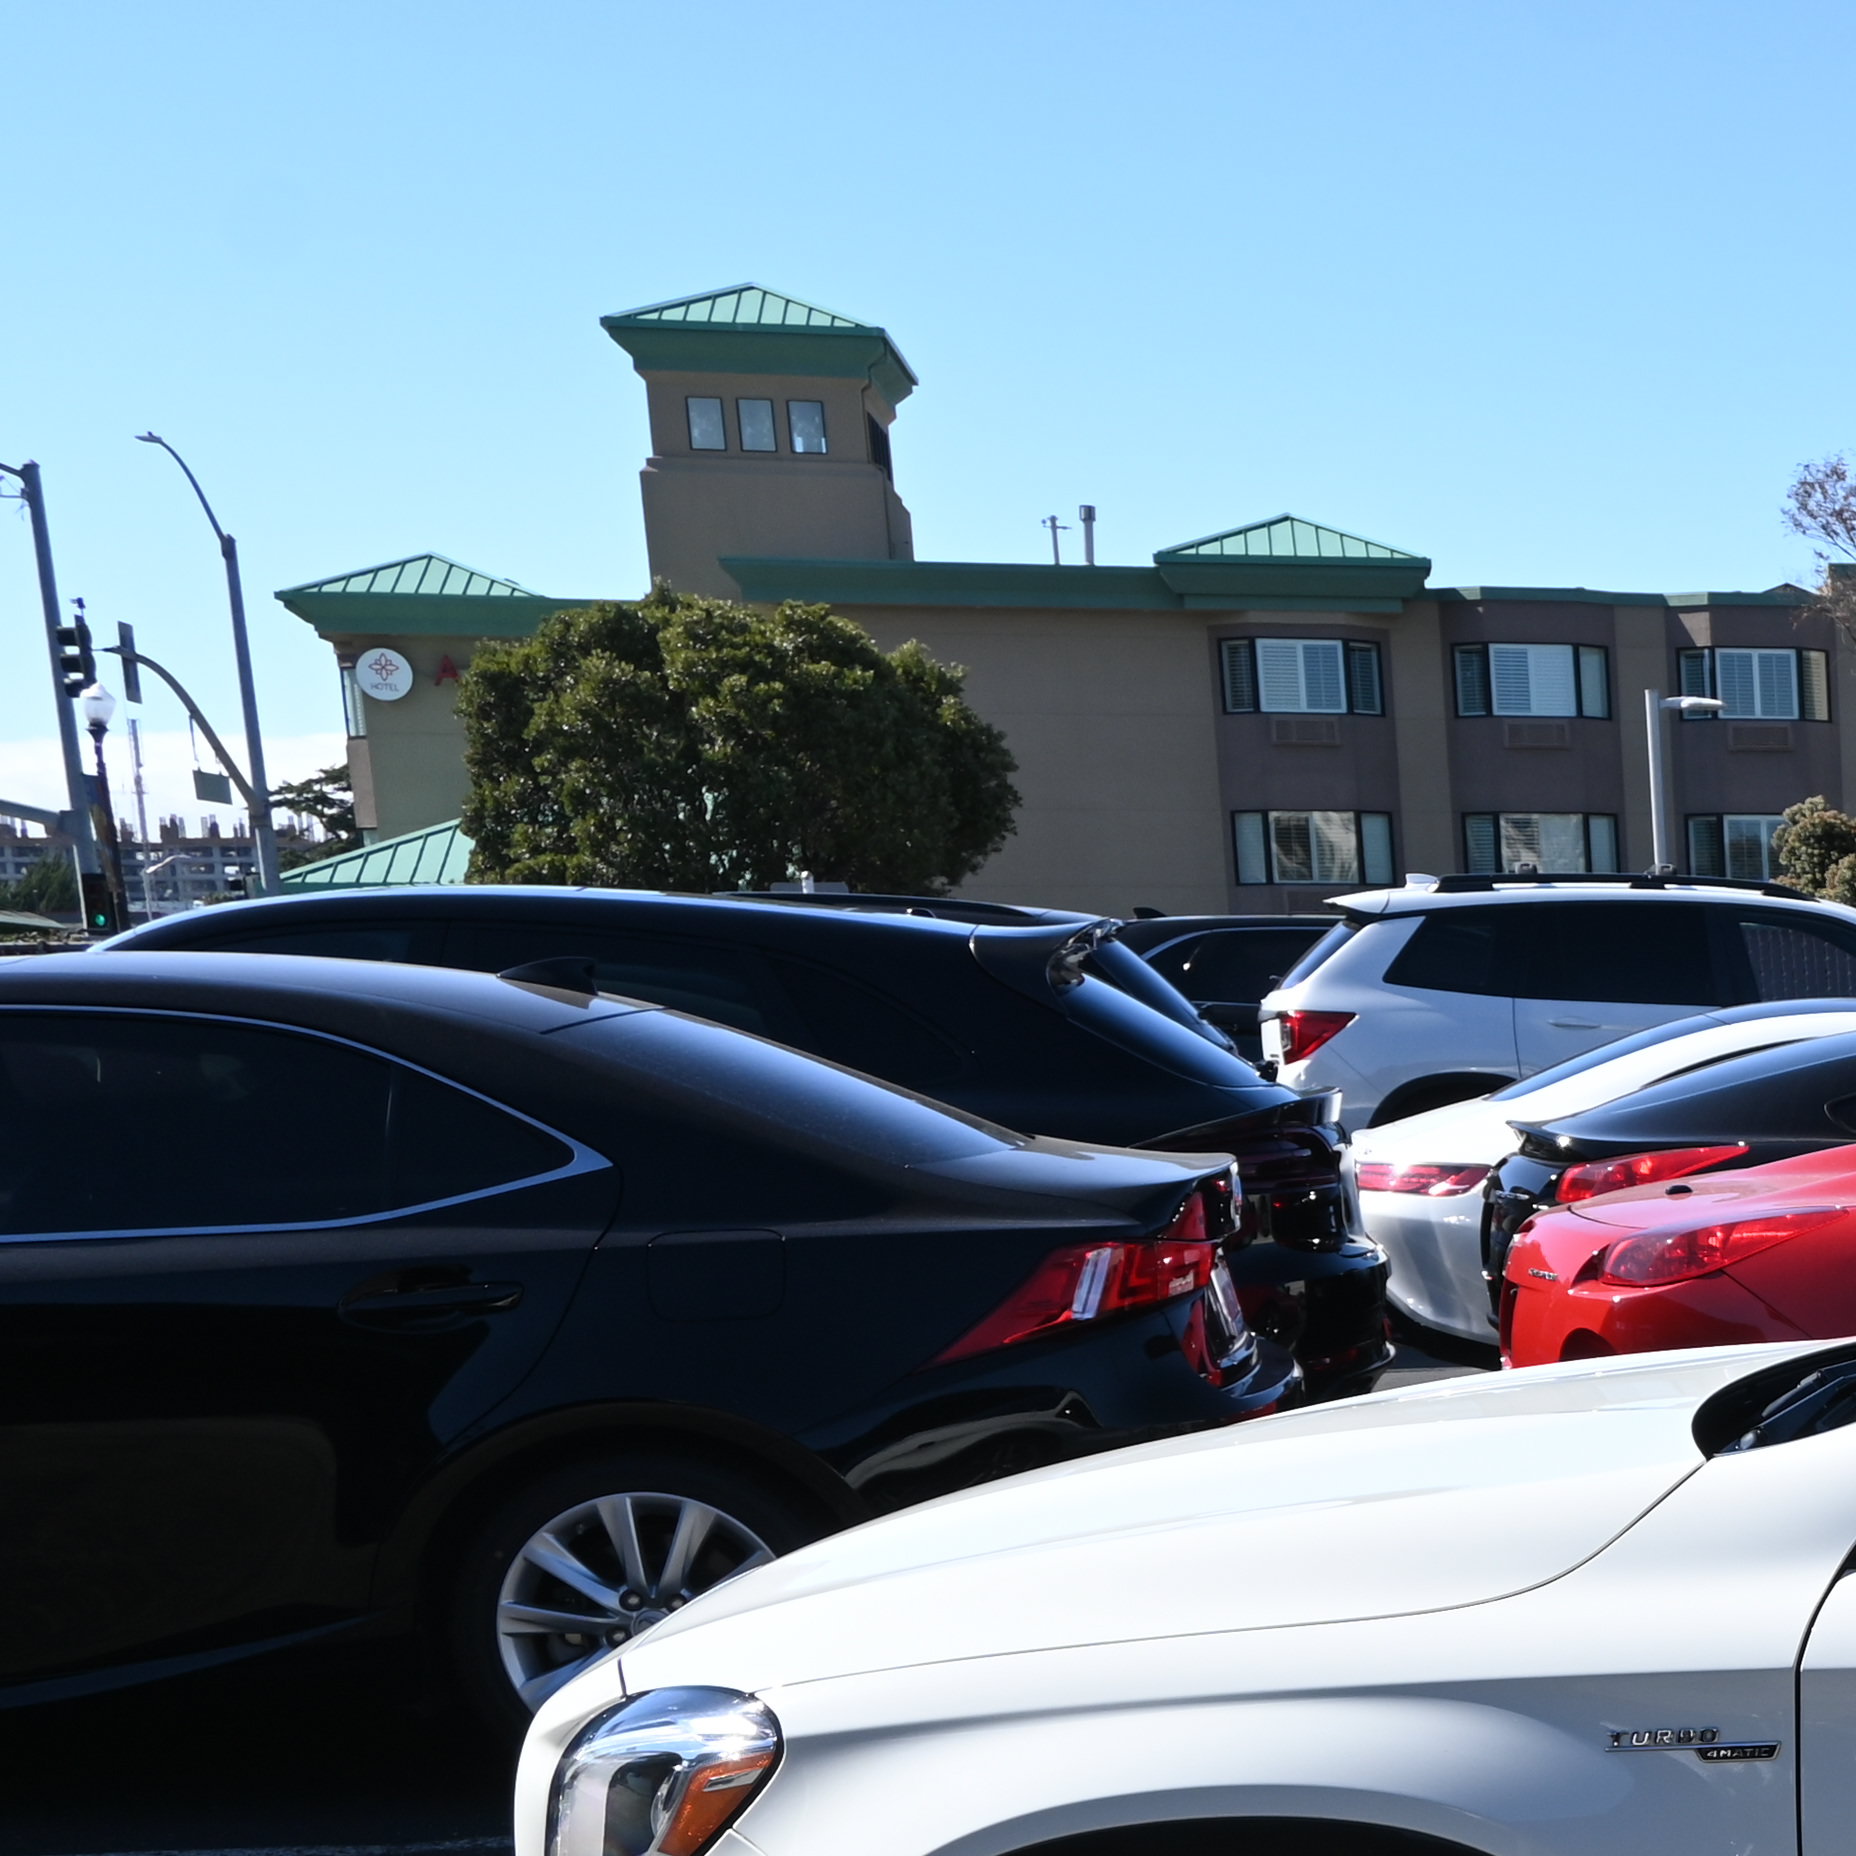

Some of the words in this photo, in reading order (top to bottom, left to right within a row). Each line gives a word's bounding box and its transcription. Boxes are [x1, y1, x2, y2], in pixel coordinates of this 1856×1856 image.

[370, 683, 399, 692] HOTEL
[1607, 1727, 1719, 1747] TURBO
[1706, 1747, 1770, 1759] 4MATIC
